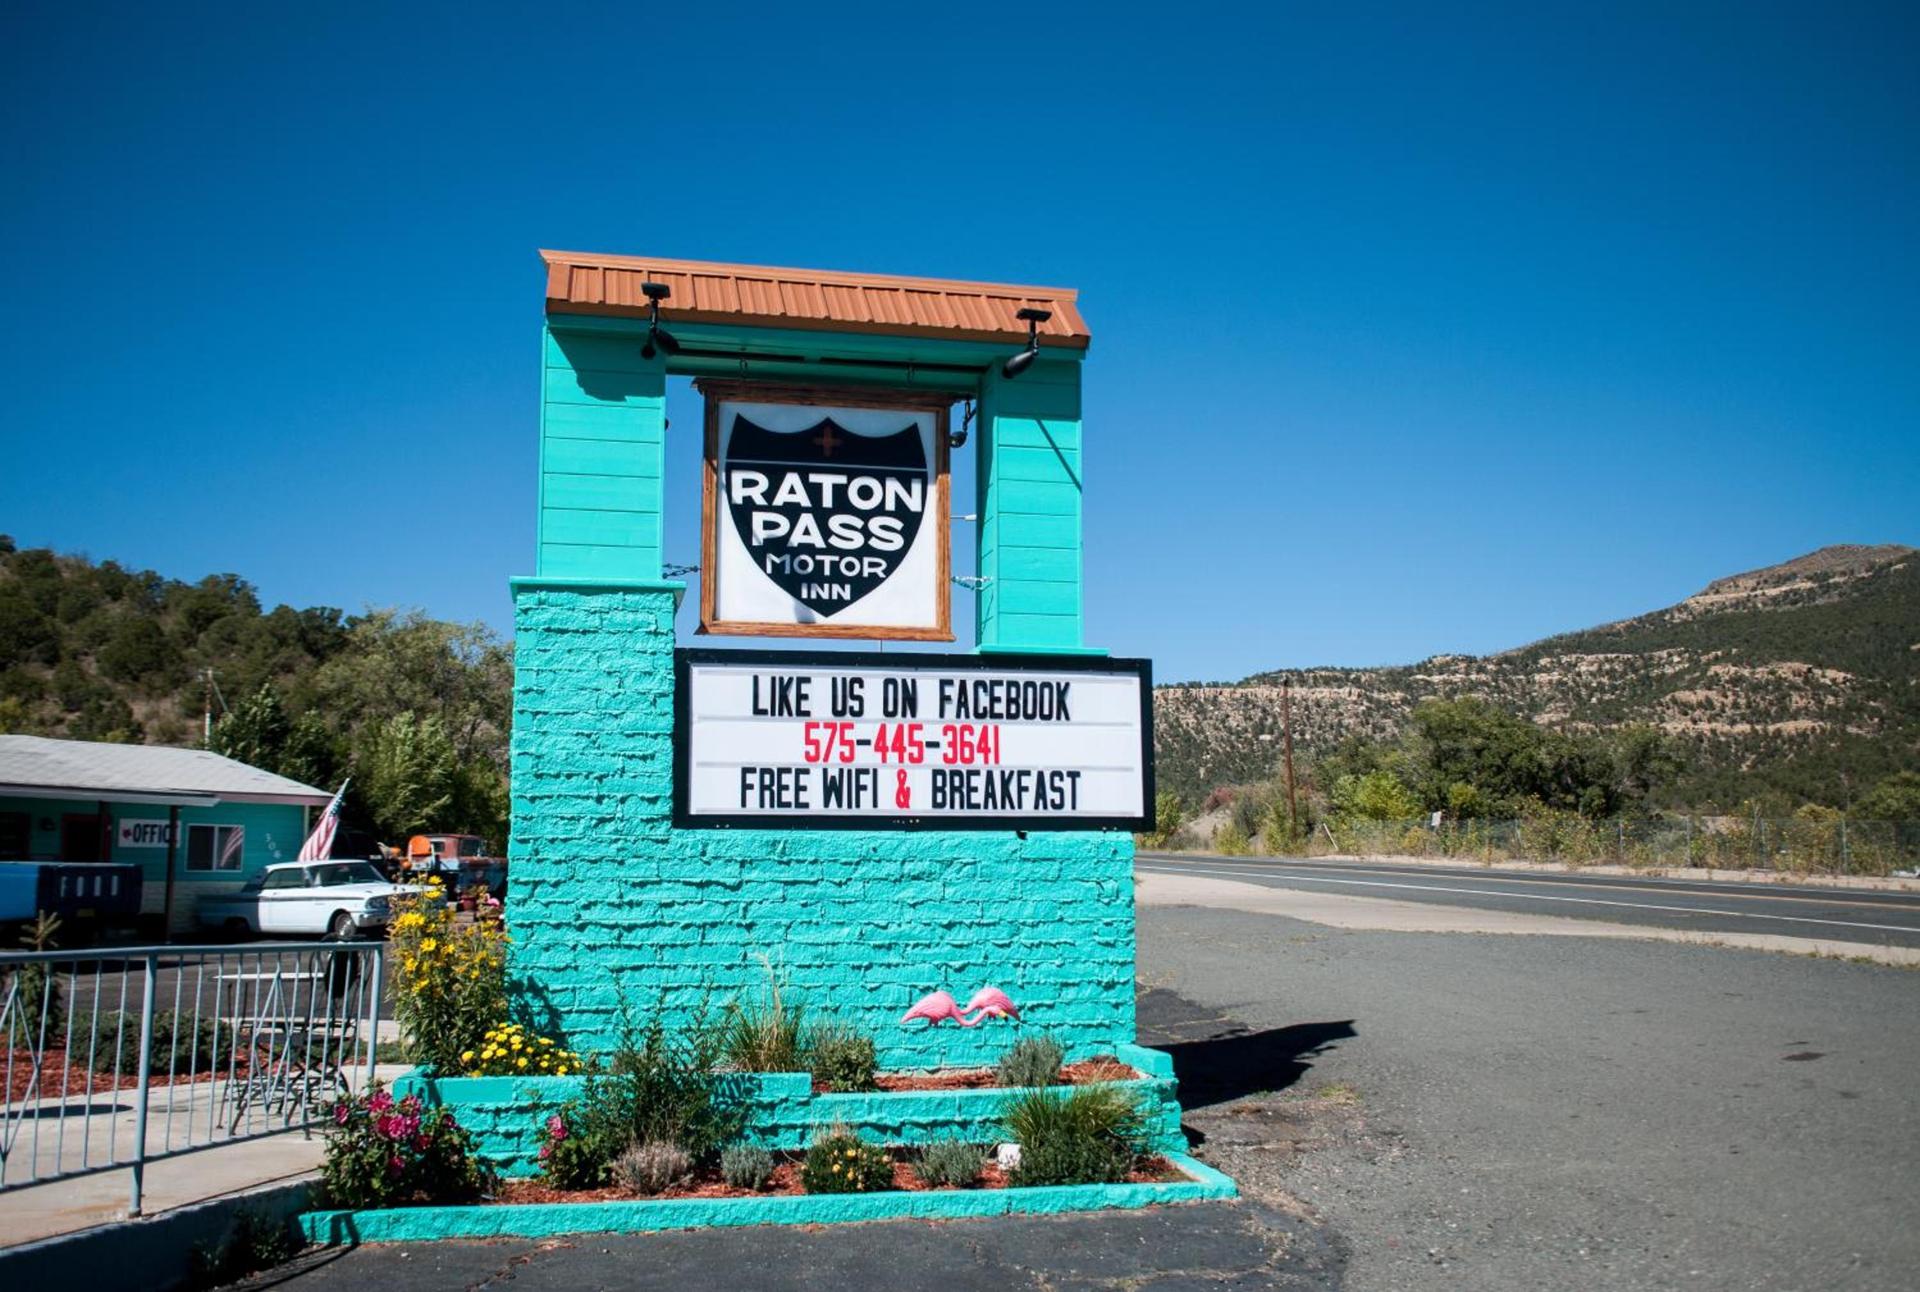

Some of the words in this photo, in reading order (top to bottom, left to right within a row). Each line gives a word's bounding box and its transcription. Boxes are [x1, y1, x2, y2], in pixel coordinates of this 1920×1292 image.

[730, 470, 923, 512] RATON
[751, 511, 905, 551] PASS
[766, 553, 888, 578] MOTOR
[801, 583, 851, 600] INN
[752, 675, 812, 717] LIKE
[831, 676, 864, 717] US
[882, 678, 918, 719] ON
[938, 679, 1071, 721] FACEBOOK
[804, 721, 1000, 765] 575-445-3641
[740, 767, 811, 809] FREE
[822, 768, 878, 809] WIFI
[895, 768, 911, 810] &
[931, 769, 1081, 811] BREAKFAST
[132, 823, 178, 843] OFFIC
